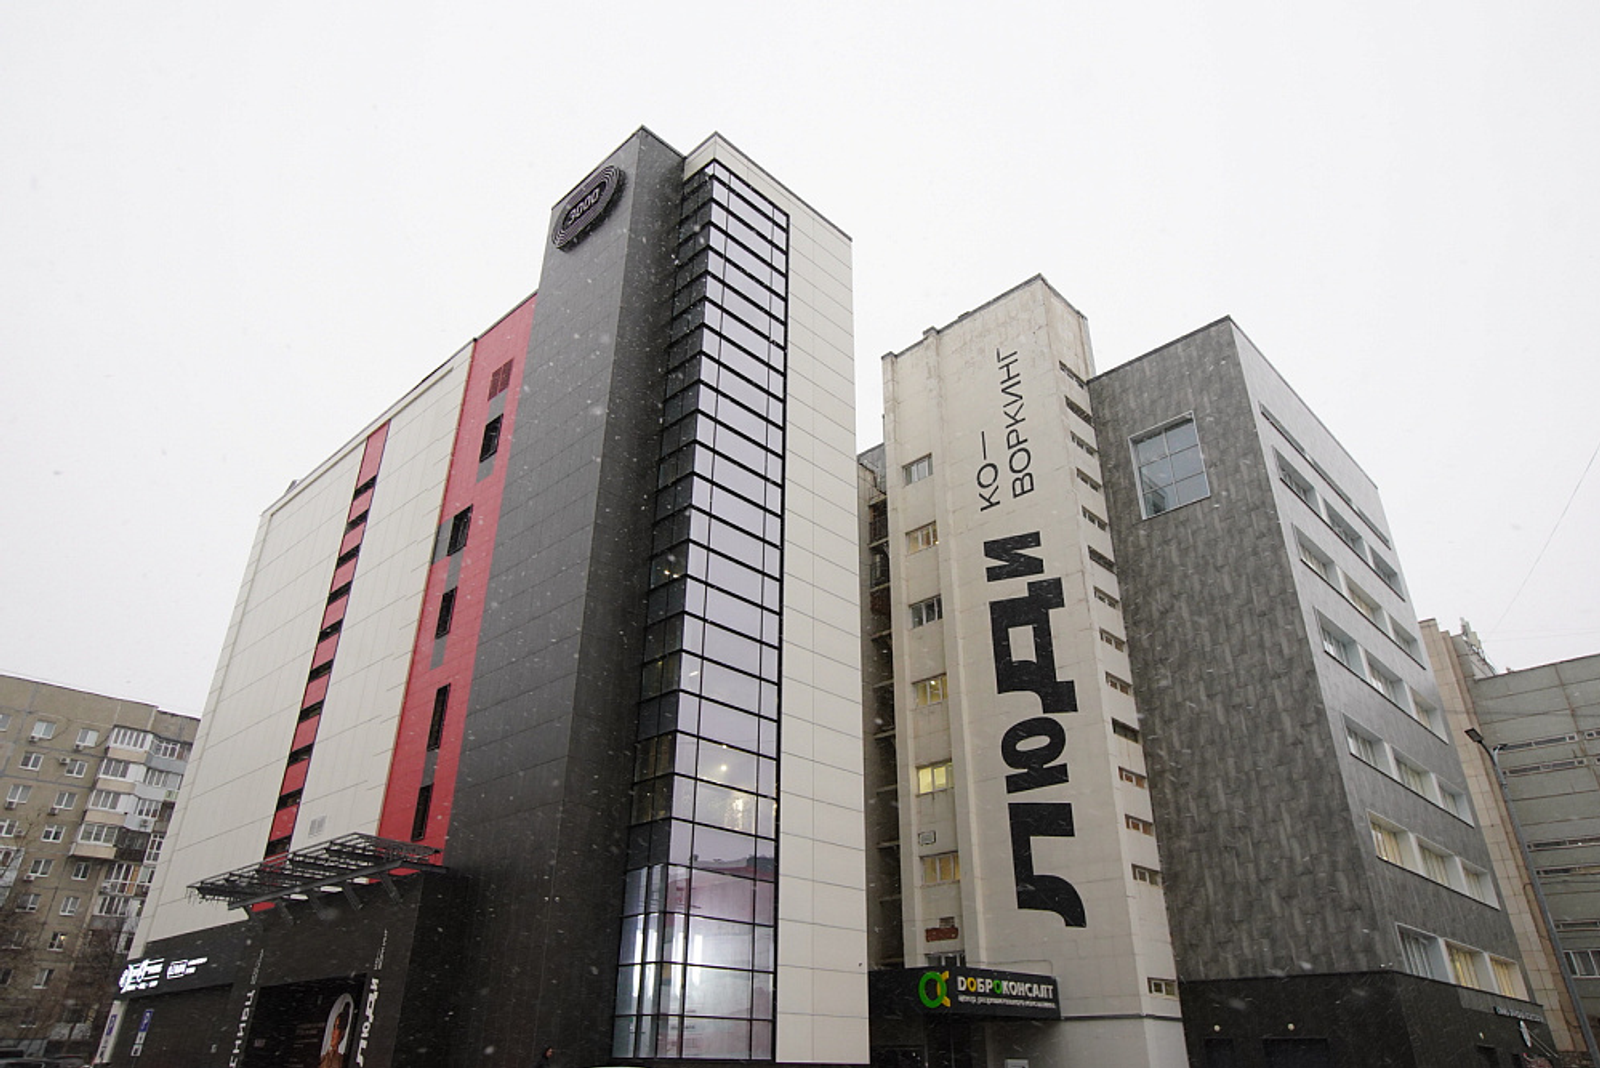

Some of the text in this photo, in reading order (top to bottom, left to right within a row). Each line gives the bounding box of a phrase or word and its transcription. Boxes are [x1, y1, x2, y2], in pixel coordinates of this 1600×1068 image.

[996, 350, 1035, 498] ВОРКИНГ
[983, 531, 1087, 929] ЛЮДИ
[355, 978, 380, 1068] ЛЮДИ
